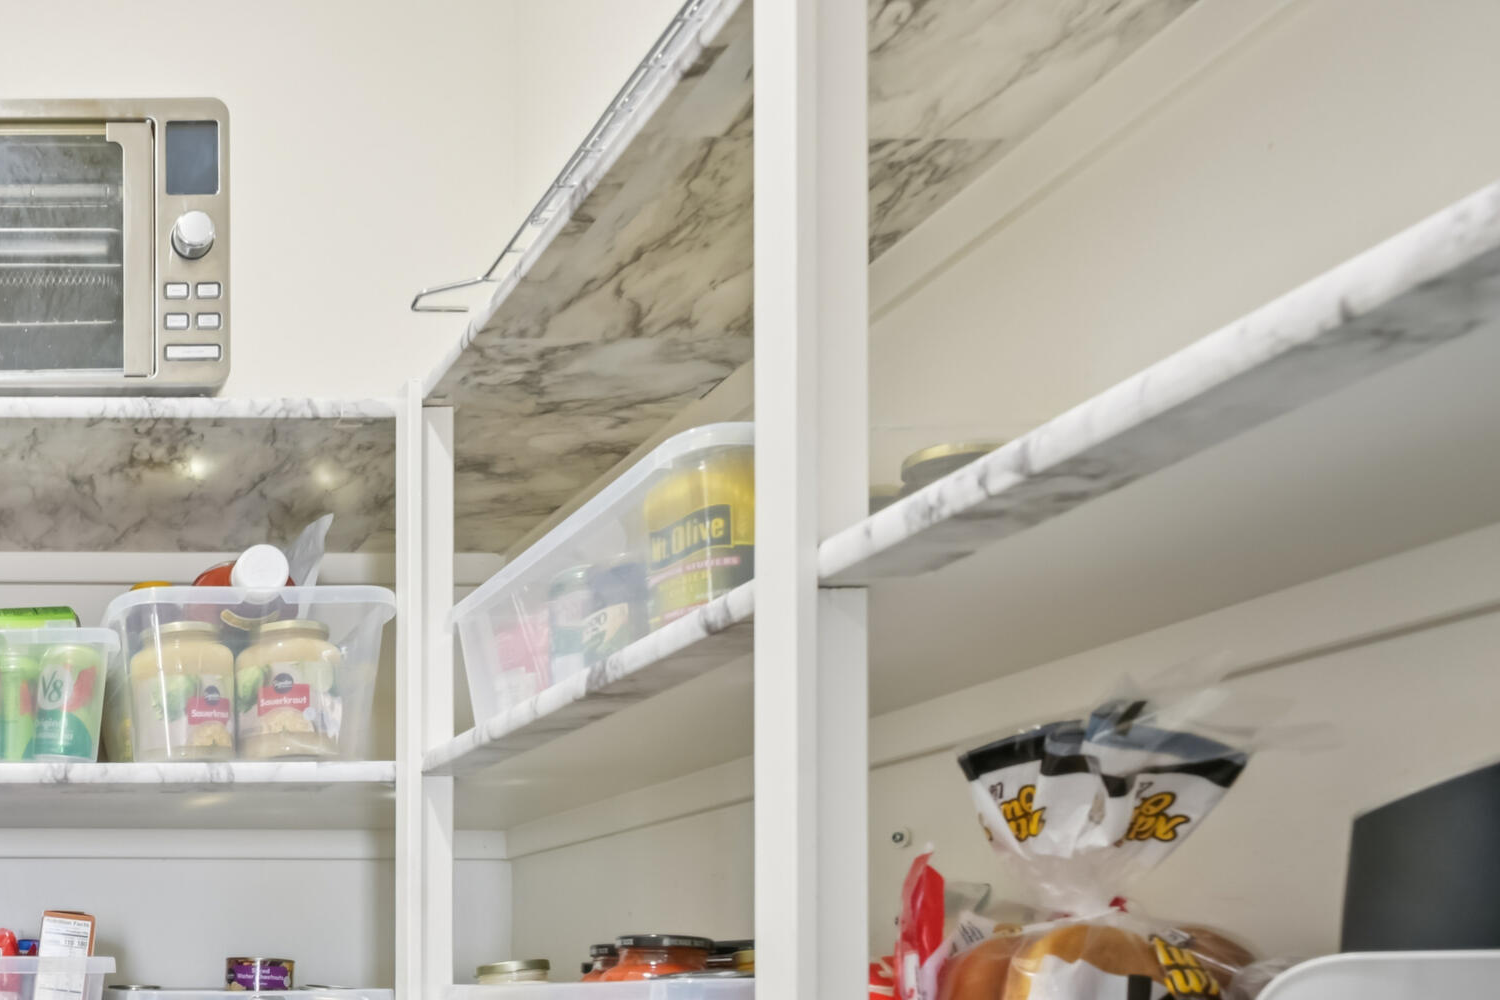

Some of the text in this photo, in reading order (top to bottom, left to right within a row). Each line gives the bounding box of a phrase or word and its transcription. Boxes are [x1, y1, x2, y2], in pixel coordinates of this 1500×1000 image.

[671, 517, 726, 555] Olive
[41, 670, 64, 703] V8
[191, 708, 229, 718] Sauerkrau
[260, 695, 307, 708] Sauerkraut
